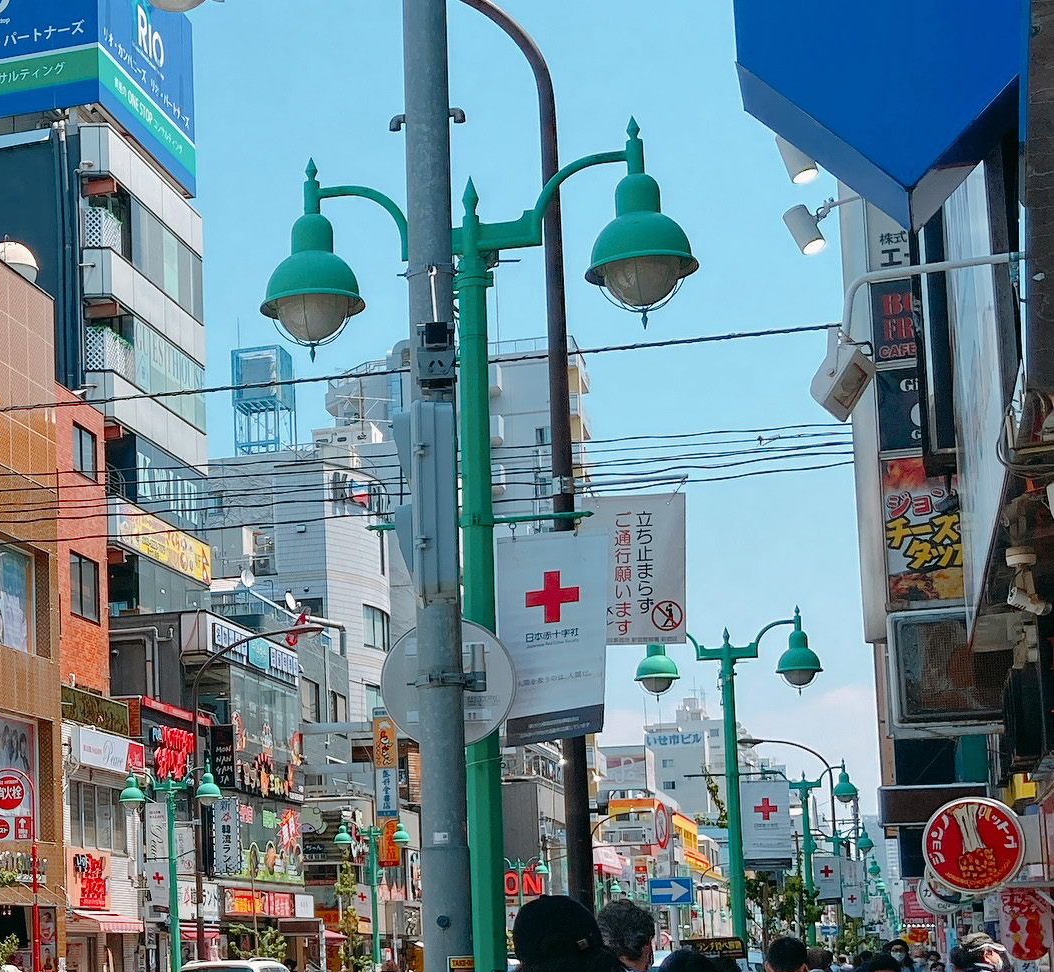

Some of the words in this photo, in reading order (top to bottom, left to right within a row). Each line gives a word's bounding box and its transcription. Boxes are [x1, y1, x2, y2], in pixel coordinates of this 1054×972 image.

[137, 4, 165, 68] RIO
[879, 343, 917, 359] CAFE
[886, 513, 961, 548] チーズ
[636, 511, 654, 614] 立ち止まらず
[615, 511, 632, 636] ご通行願います
[525, 628, 579, 643] 日本赤十字社
[646, 733, 703, 746] いせ市ビル
[215, 745, 232, 753] MON
[215, 755, 233, 765] NAN
[220, 799, 232, 812] 新
[221, 823, 234, 873] 韓流ランド
